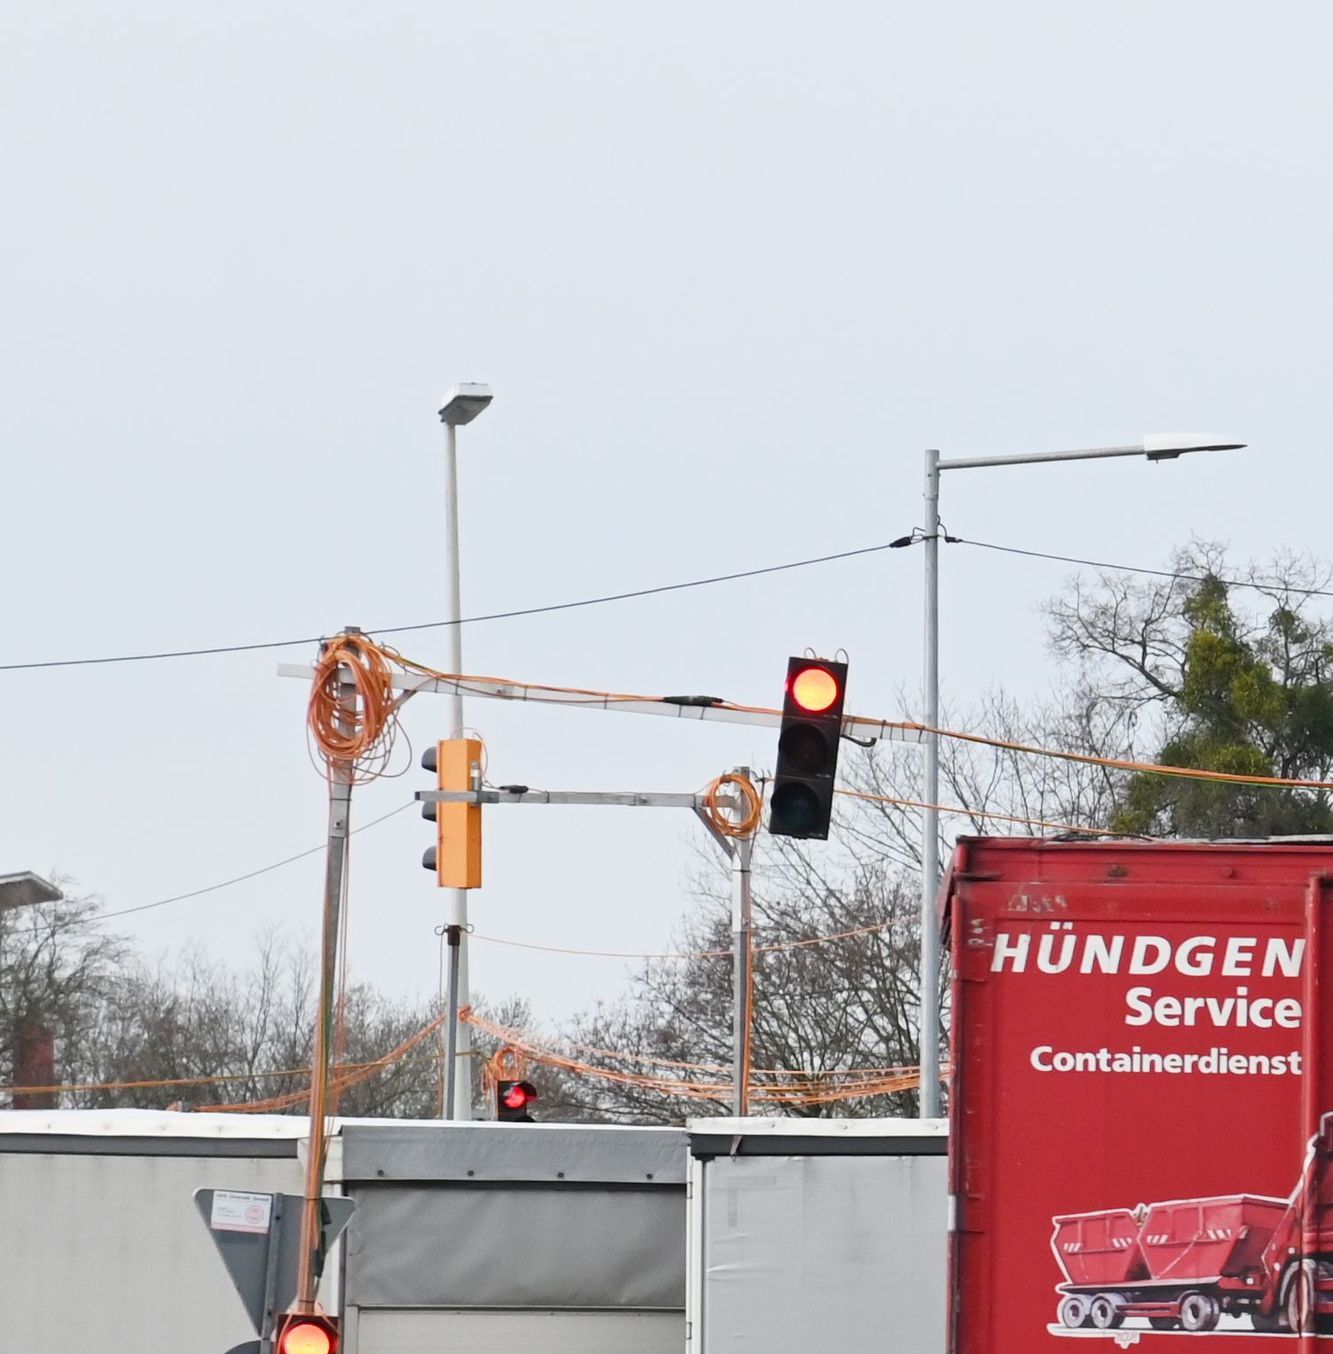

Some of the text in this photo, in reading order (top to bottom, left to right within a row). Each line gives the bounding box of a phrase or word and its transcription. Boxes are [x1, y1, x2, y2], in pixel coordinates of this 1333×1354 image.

[990, 922, 1306, 977] HÜNDGEN
[1125, 986, 1302, 1029] Service
[1030, 1046, 1302, 1075] Containerdienst
